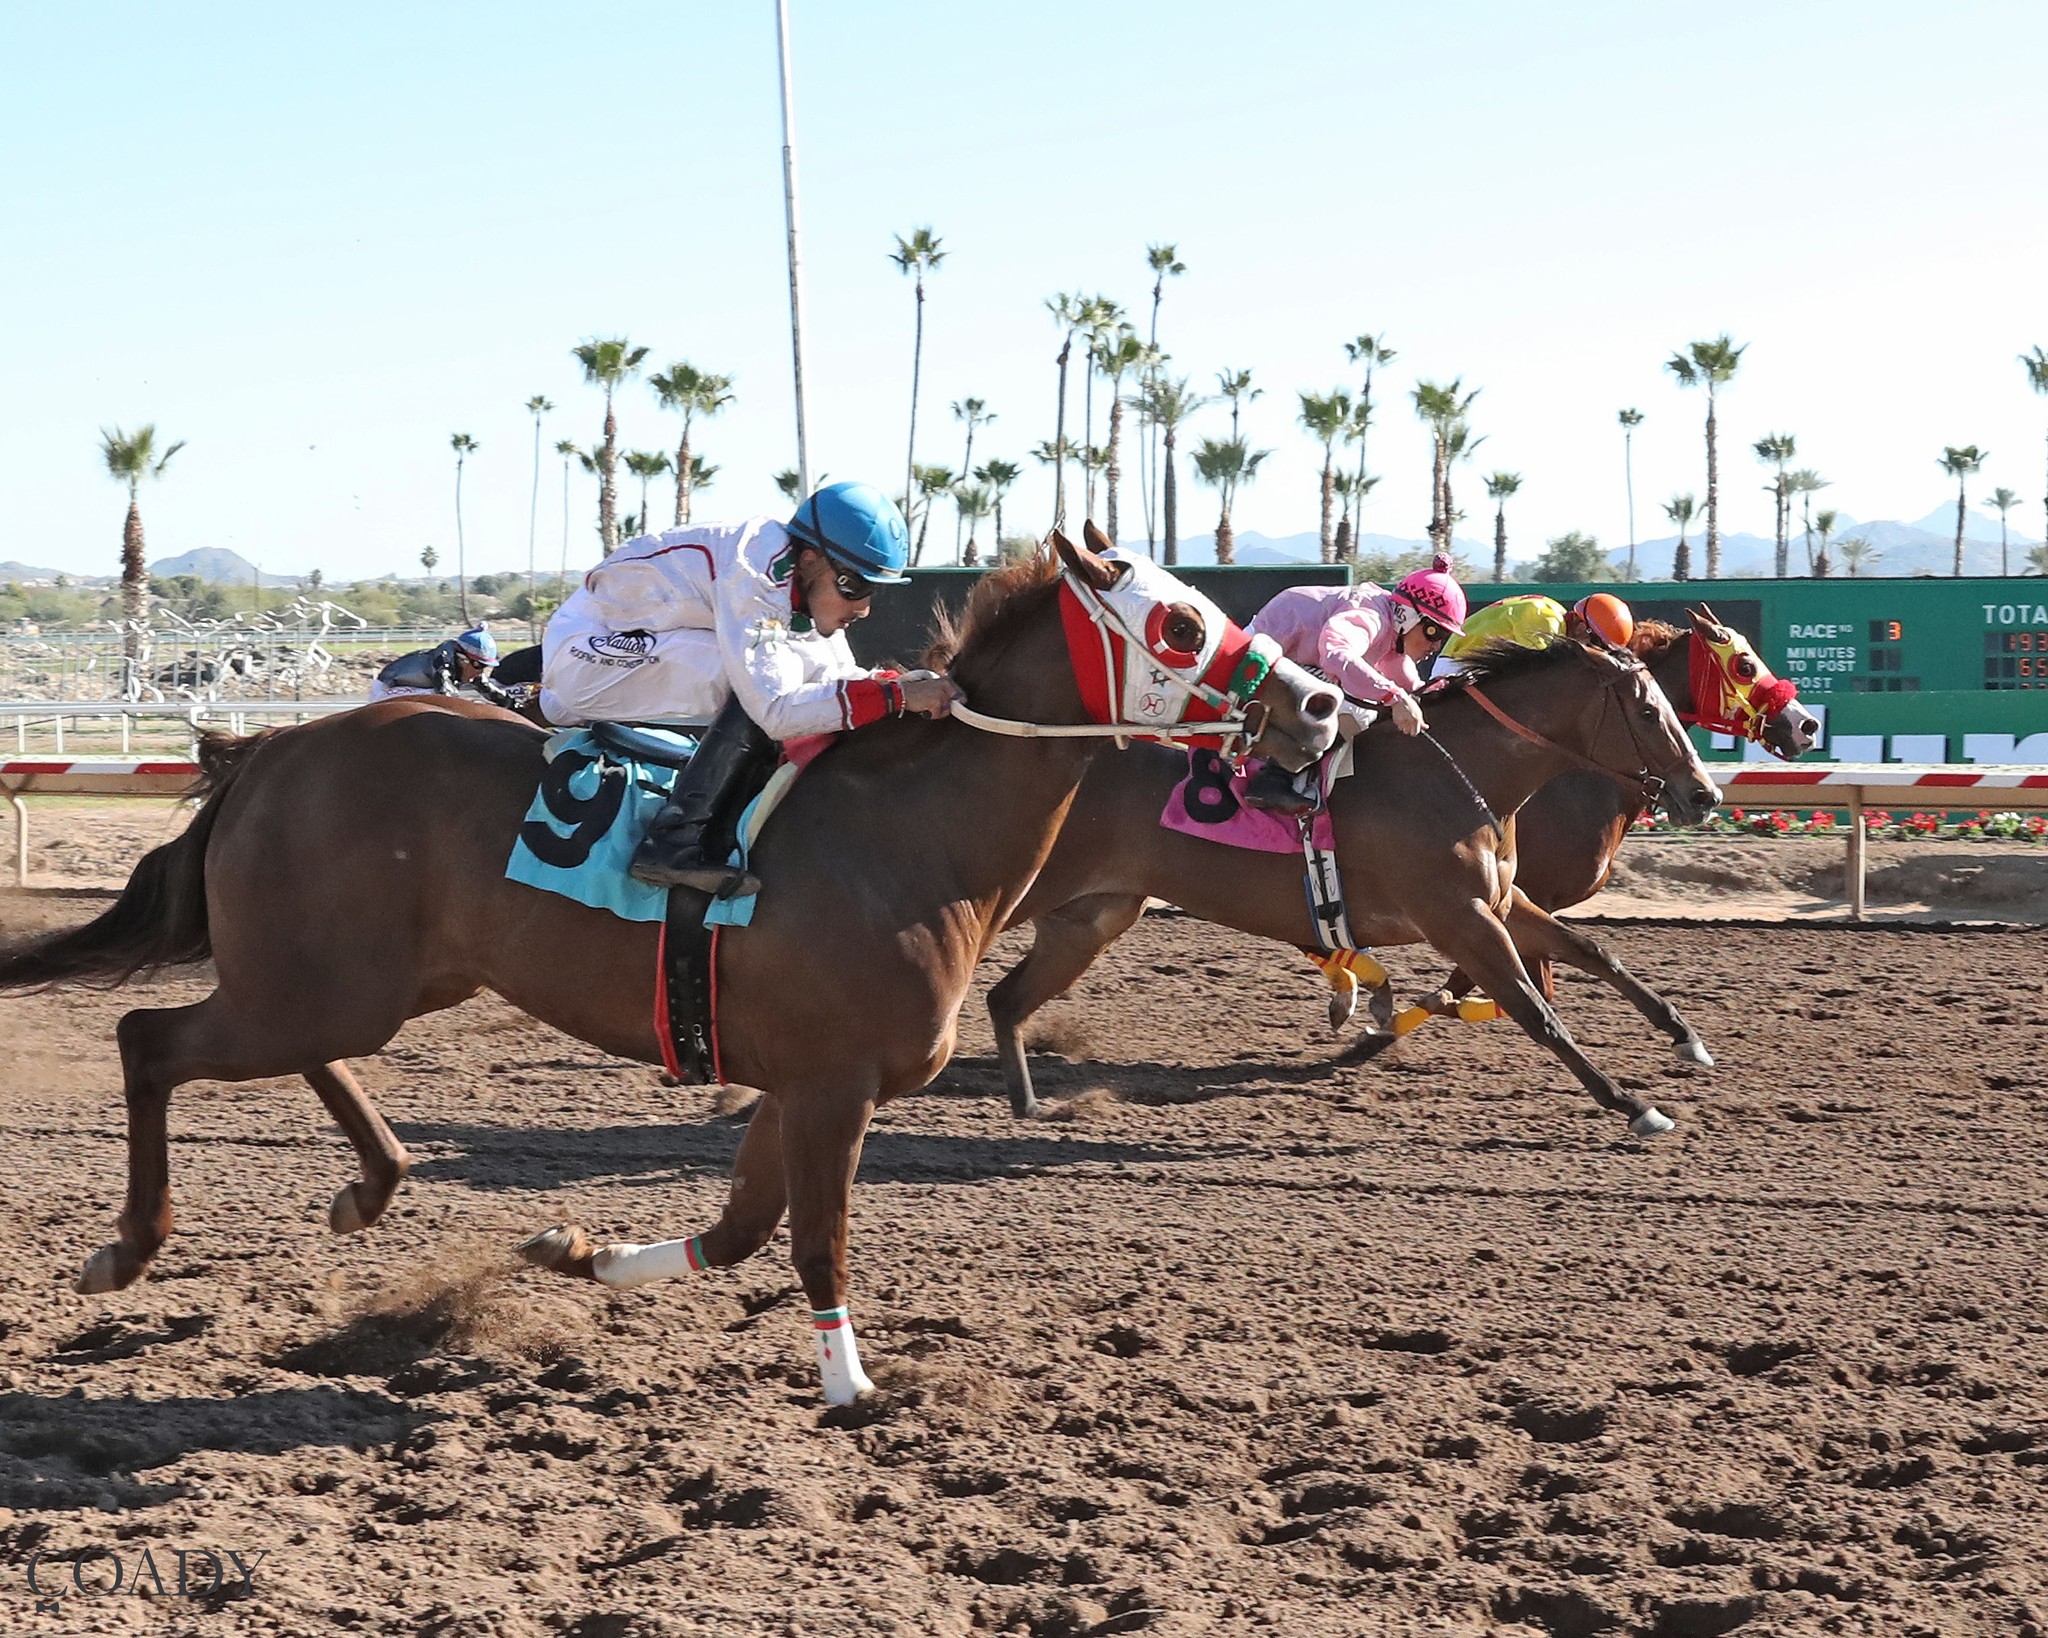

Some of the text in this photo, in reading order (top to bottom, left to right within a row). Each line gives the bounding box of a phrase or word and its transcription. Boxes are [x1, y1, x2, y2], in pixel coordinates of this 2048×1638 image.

[1789, 624, 1838, 639] RACE
[1888, 621, 1902, 640] 3
[1786, 647, 1856, 658] MINUTES
[1786, 660, 1856, 672] TO POST
[1184, 747, 1240, 824] 8
[520, 749, 627, 869] 9
